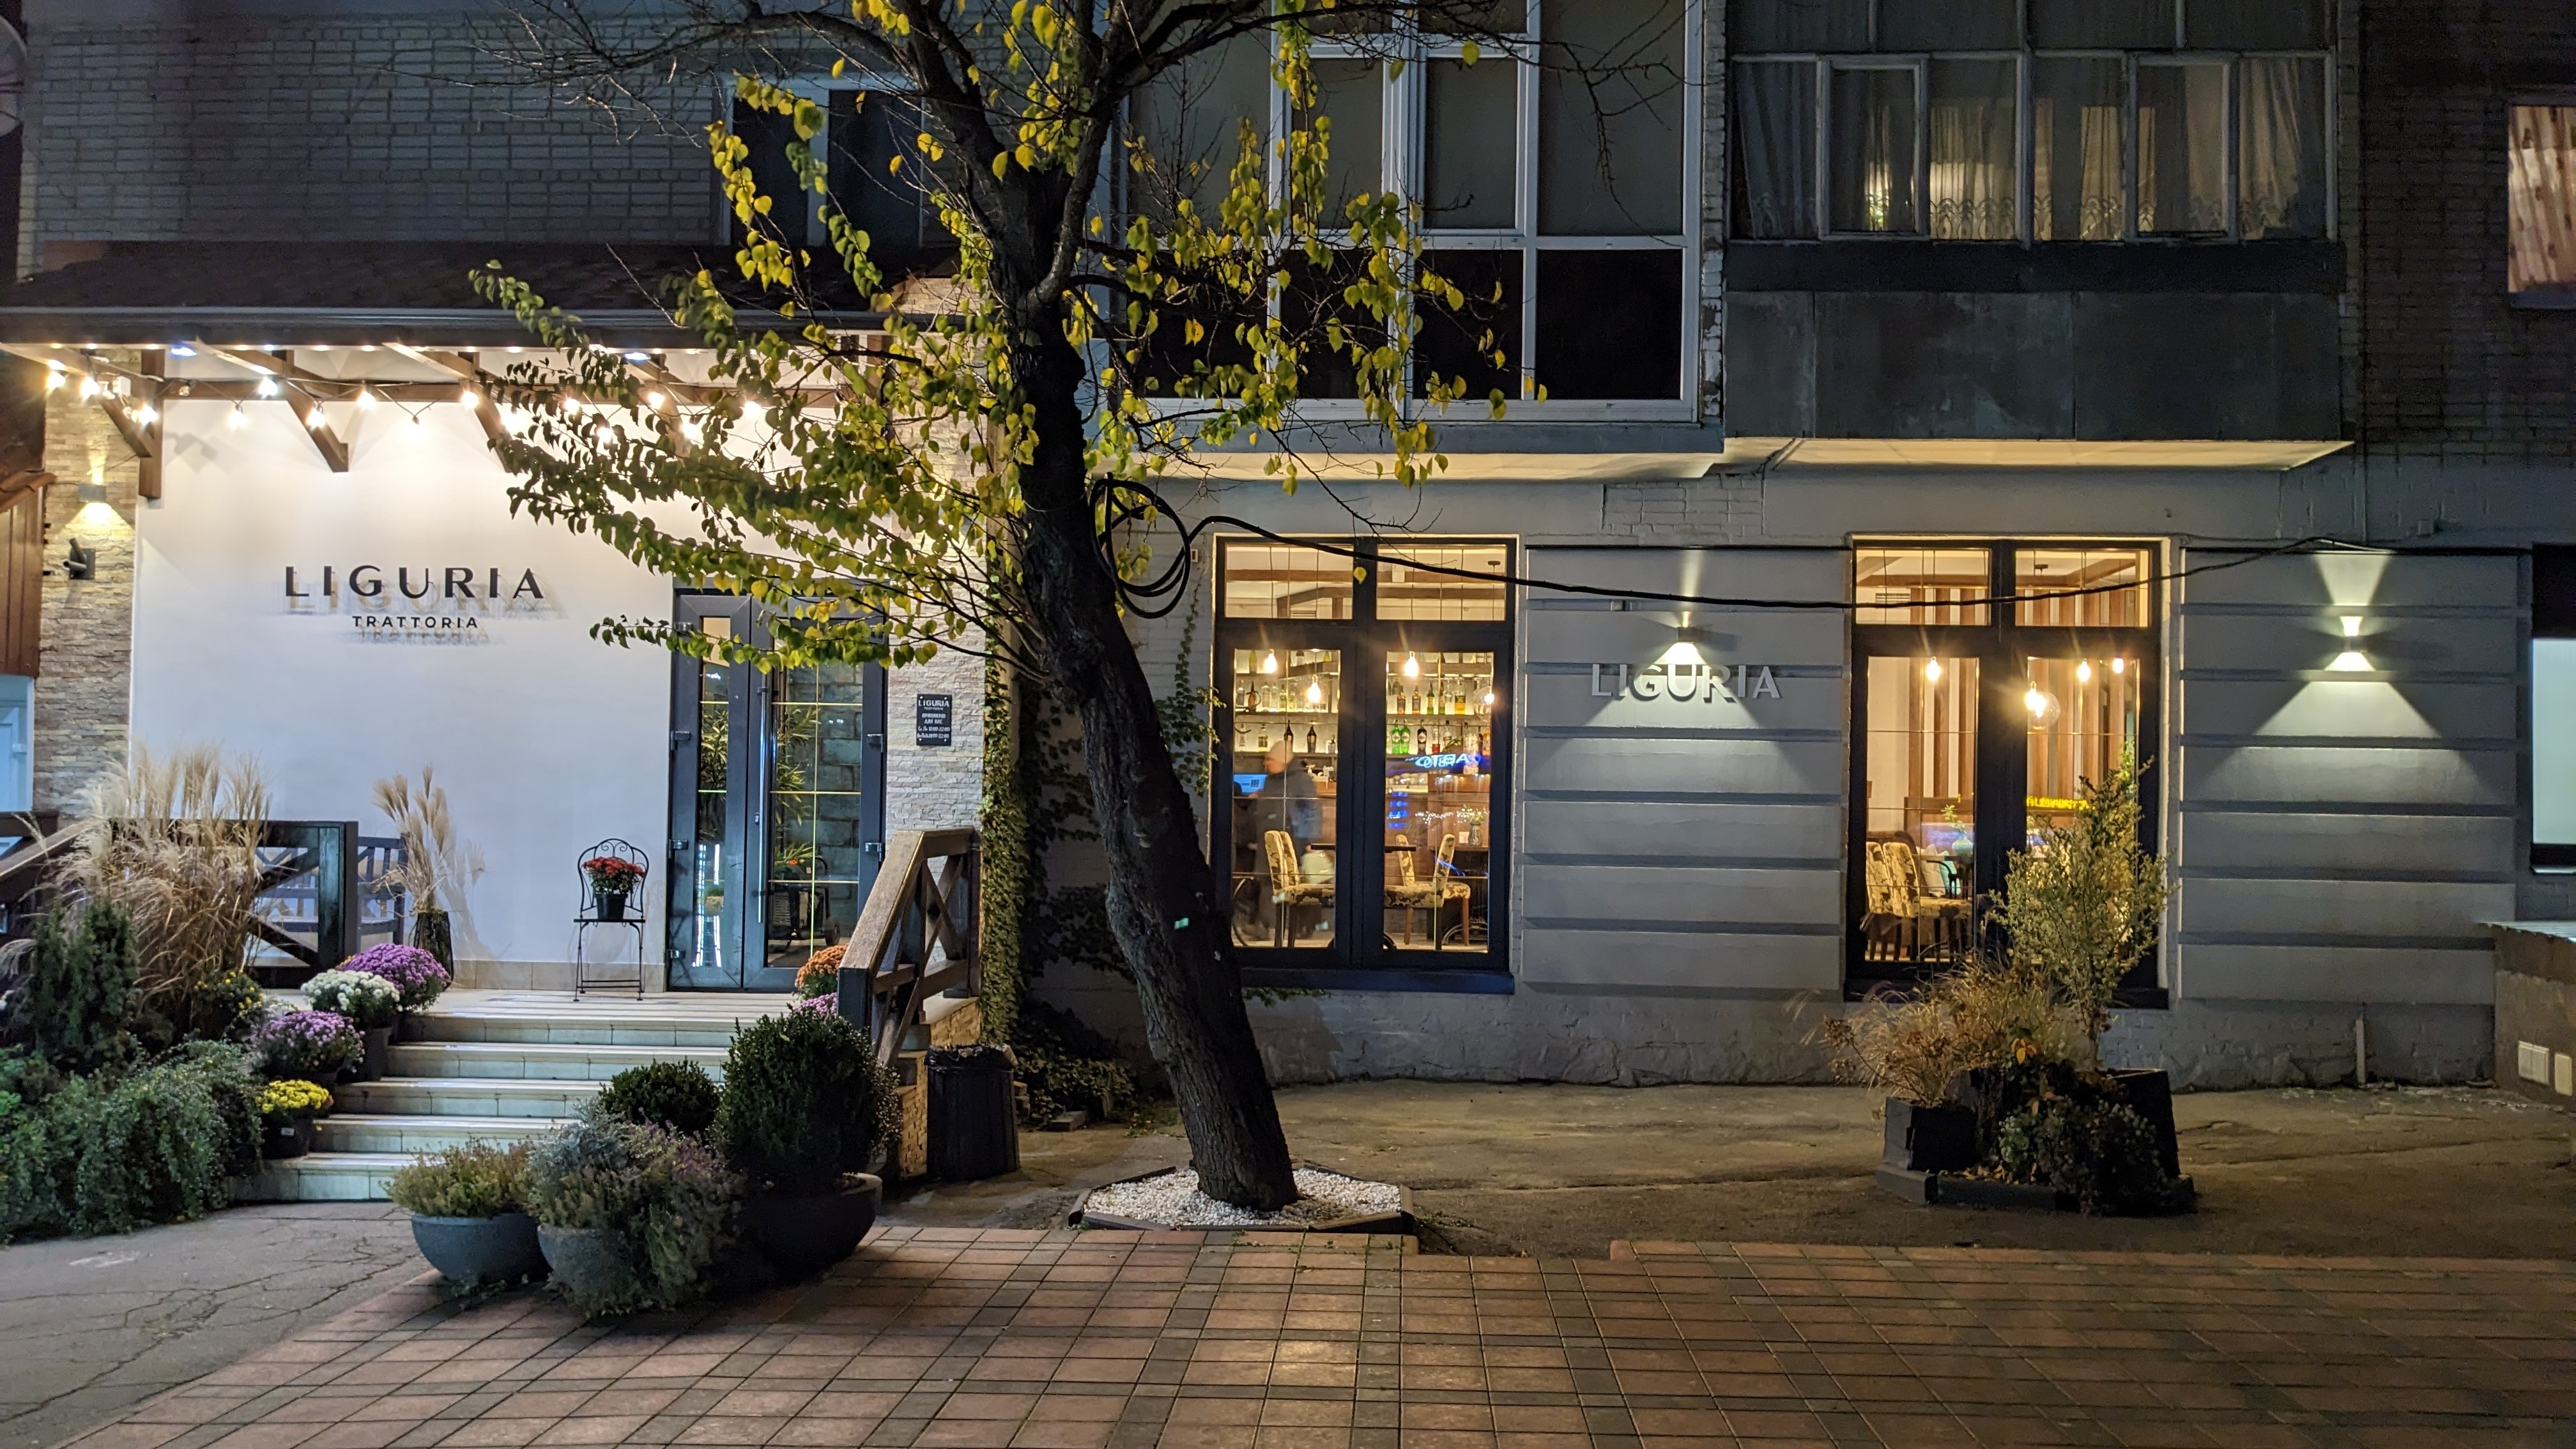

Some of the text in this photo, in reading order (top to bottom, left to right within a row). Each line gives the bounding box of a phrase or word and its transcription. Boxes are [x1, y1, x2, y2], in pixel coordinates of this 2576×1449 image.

[285, 565, 544, 599] LIGURIA
[352, 615, 478, 629] TRATTORIA
[1591, 663, 1781, 700] LIGURIA
